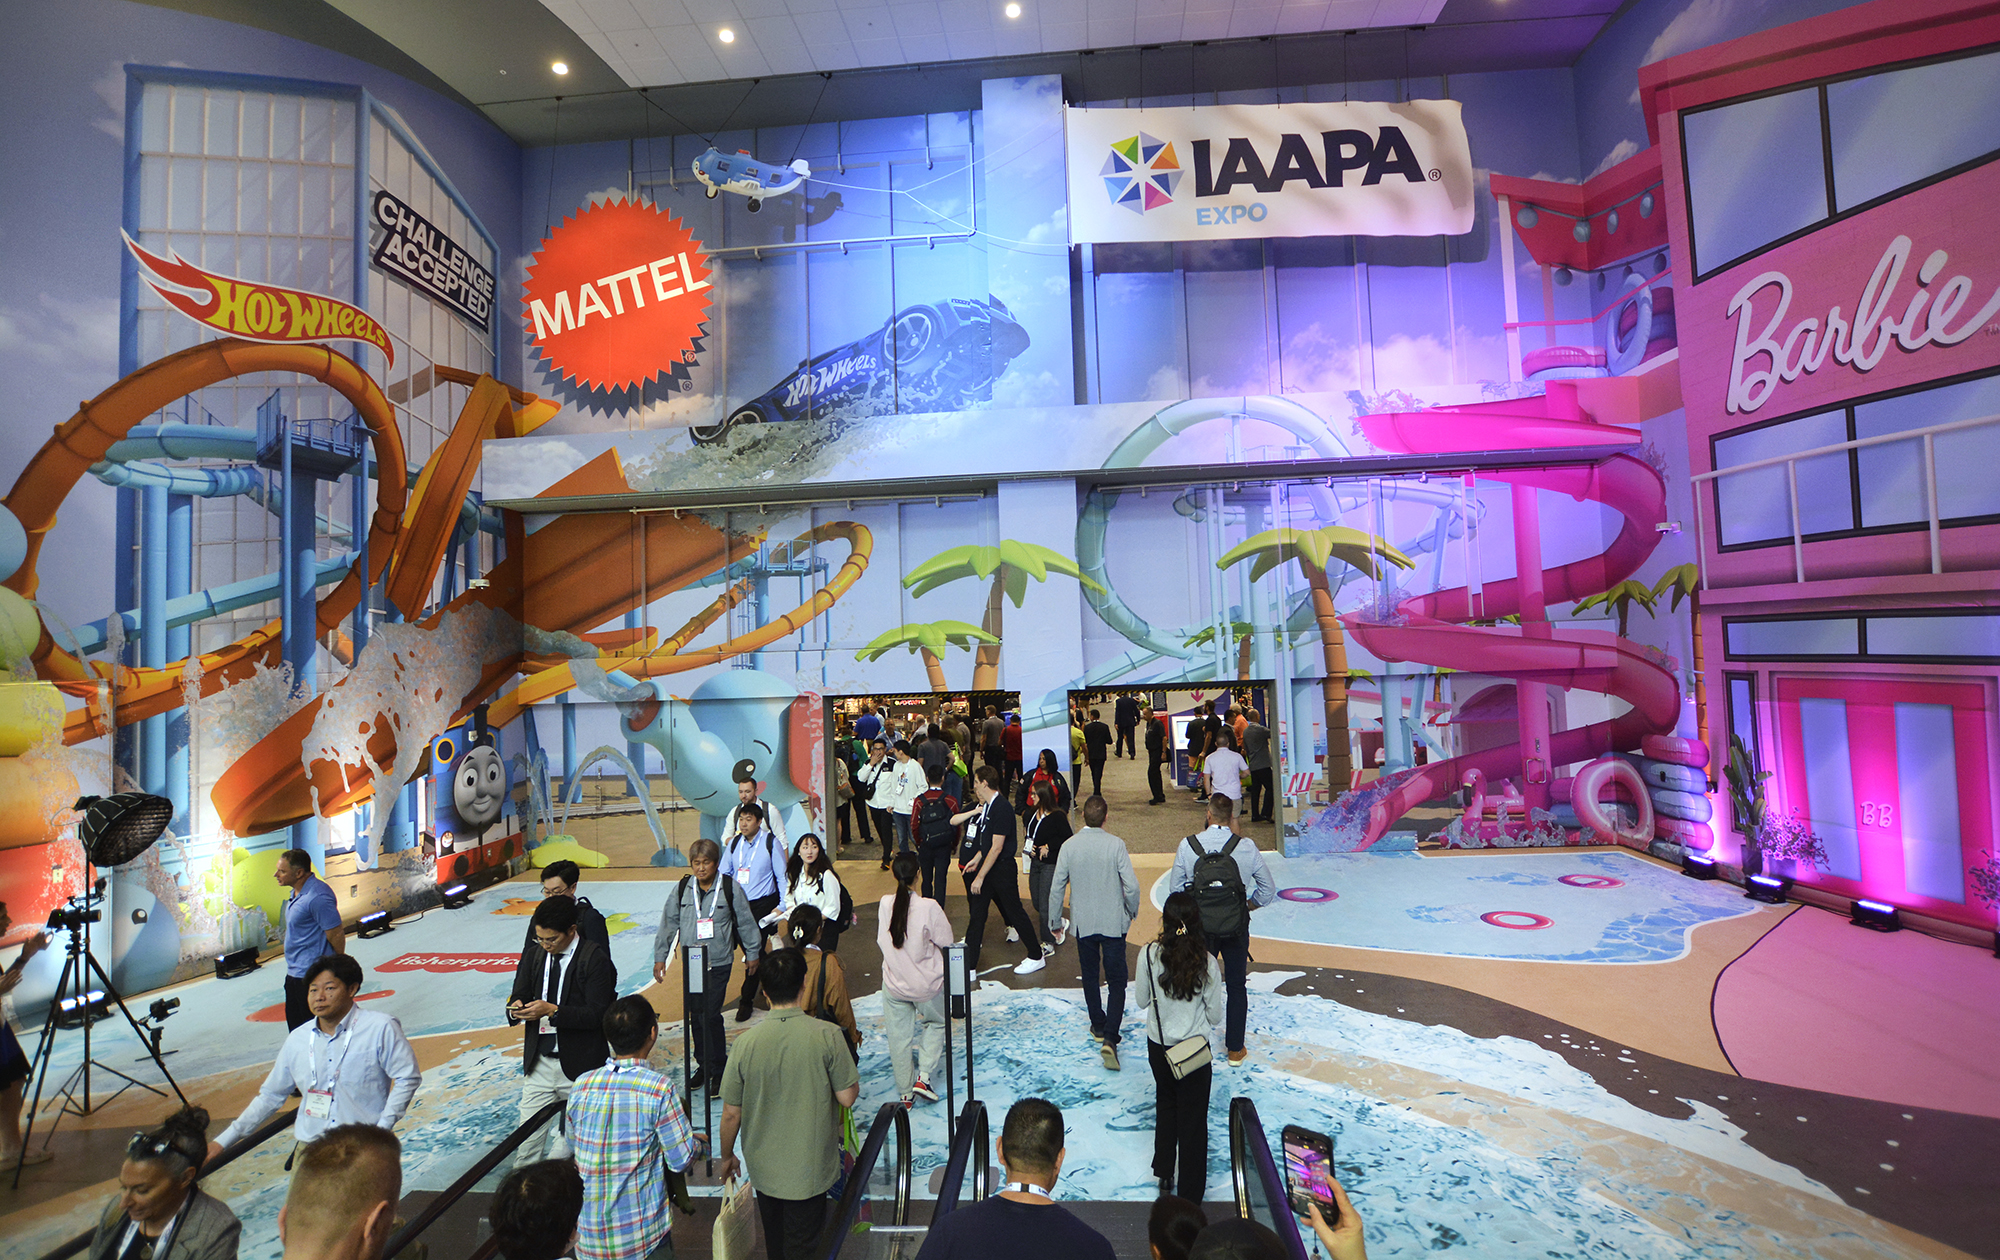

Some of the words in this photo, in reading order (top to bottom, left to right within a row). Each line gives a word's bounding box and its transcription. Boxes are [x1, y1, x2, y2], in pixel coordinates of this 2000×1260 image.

[379, 197, 494, 299] CHALLENGE
[1196, 203, 1268, 225] EXPO
[384, 233, 489, 319] ACCEPTED
[529, 252, 710, 340] MATTEL
[1726, 235, 2000, 413] Barbie
[1860, 801, 1893, 828] BB
